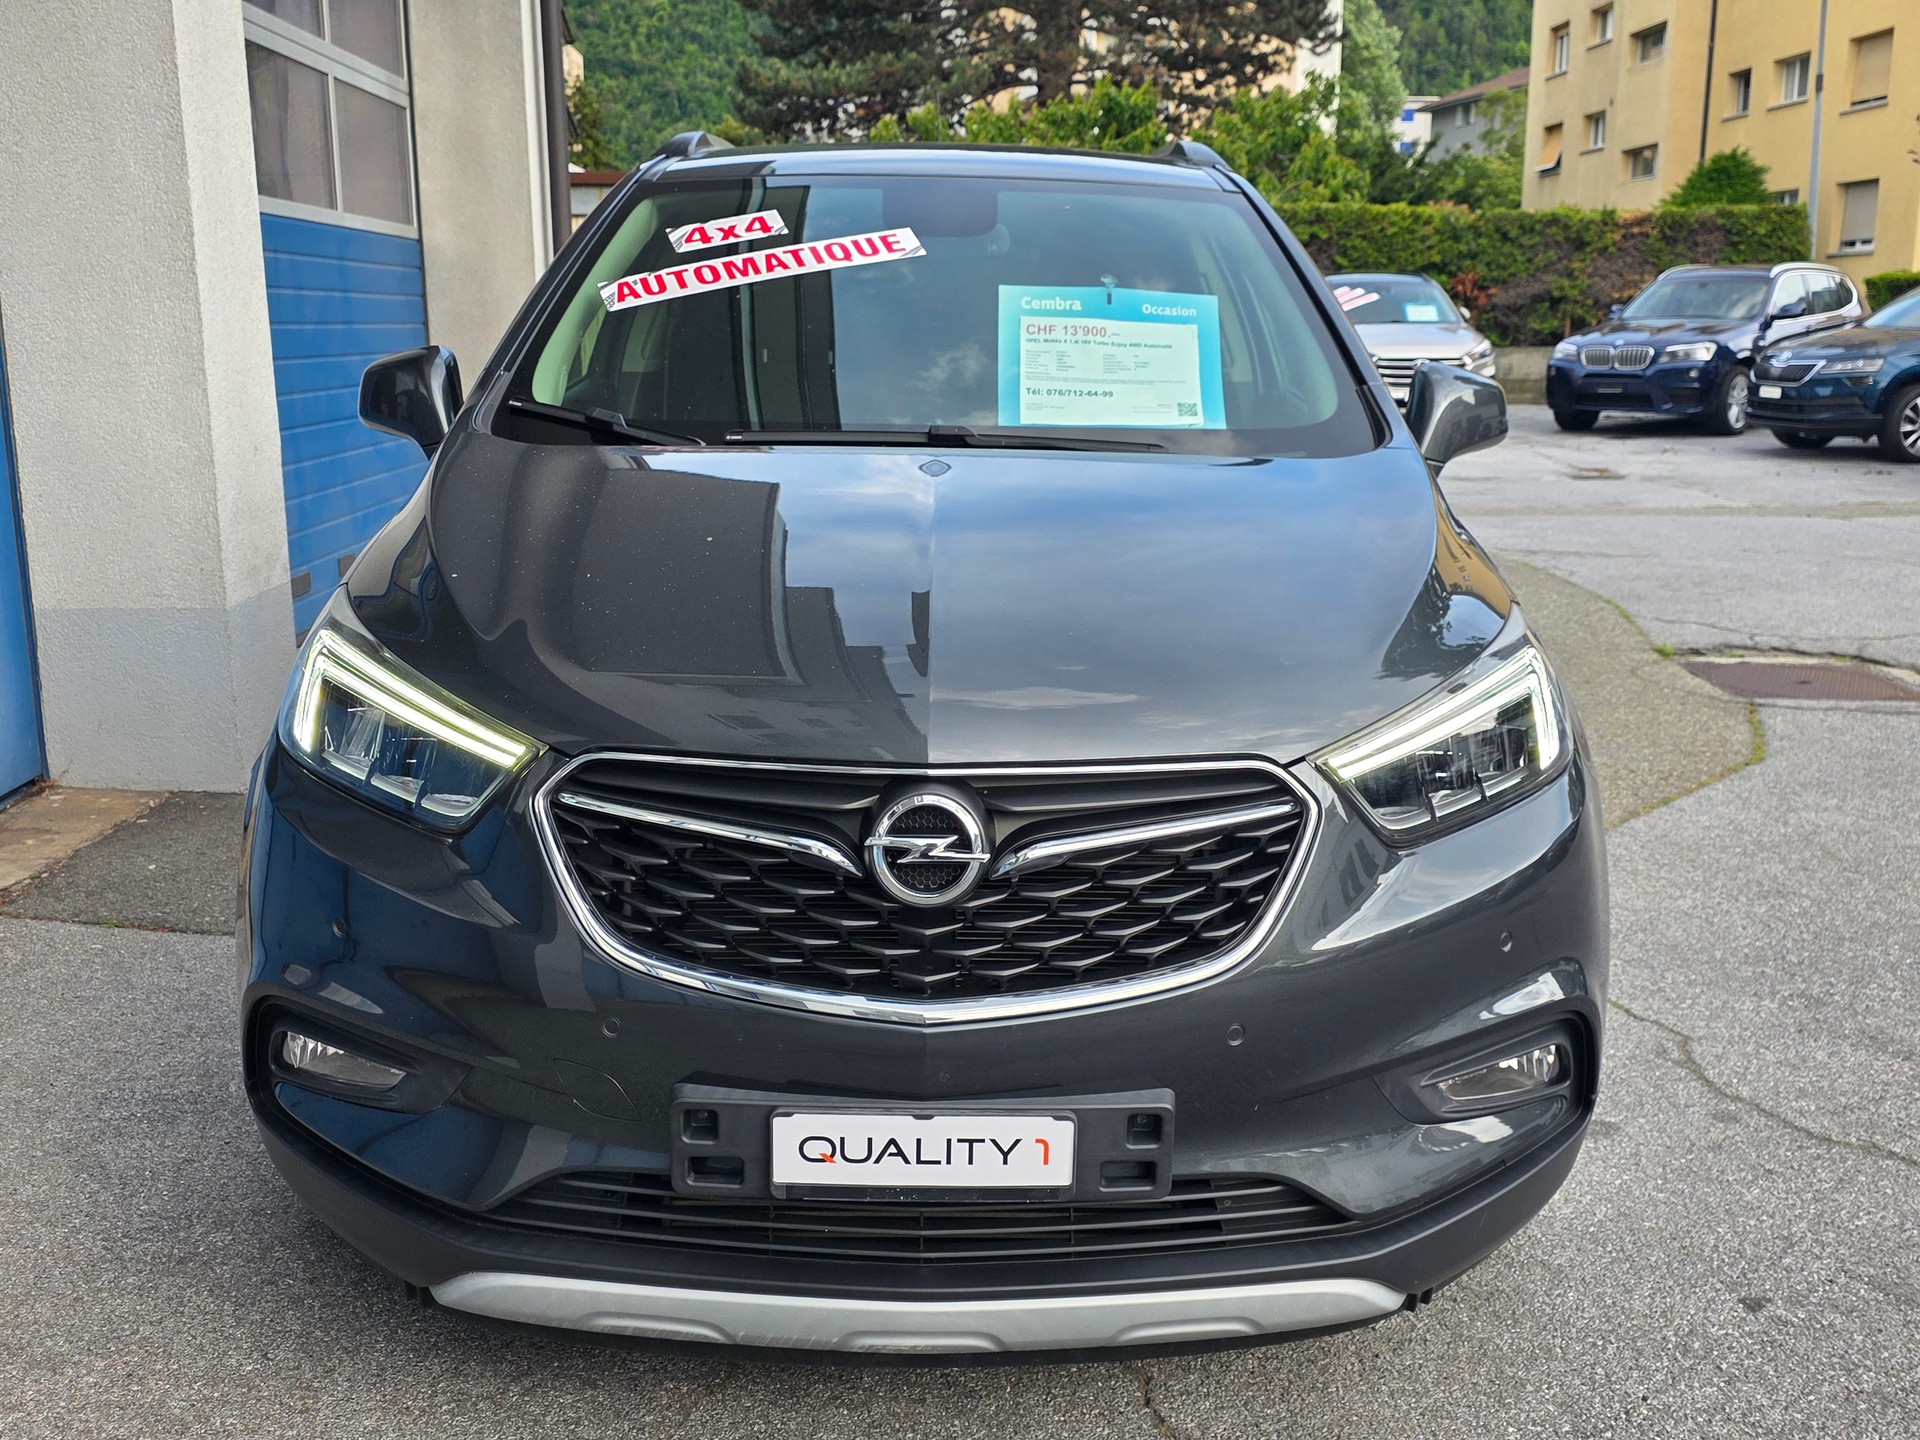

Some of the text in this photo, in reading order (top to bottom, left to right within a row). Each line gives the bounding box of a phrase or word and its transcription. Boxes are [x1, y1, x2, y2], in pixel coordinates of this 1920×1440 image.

[684, 216, 774, 245] 4x4
[616, 233, 907, 303] AUTOMATIQUE
[1020, 297, 1082, 311] Cembra
[1142, 303, 1197, 317] Occasion
[1026, 323, 1057, 336] CHF
[1025, 387, 1044, 396] Tél:
[798, 1135, 1050, 1166] QUALITY 1
